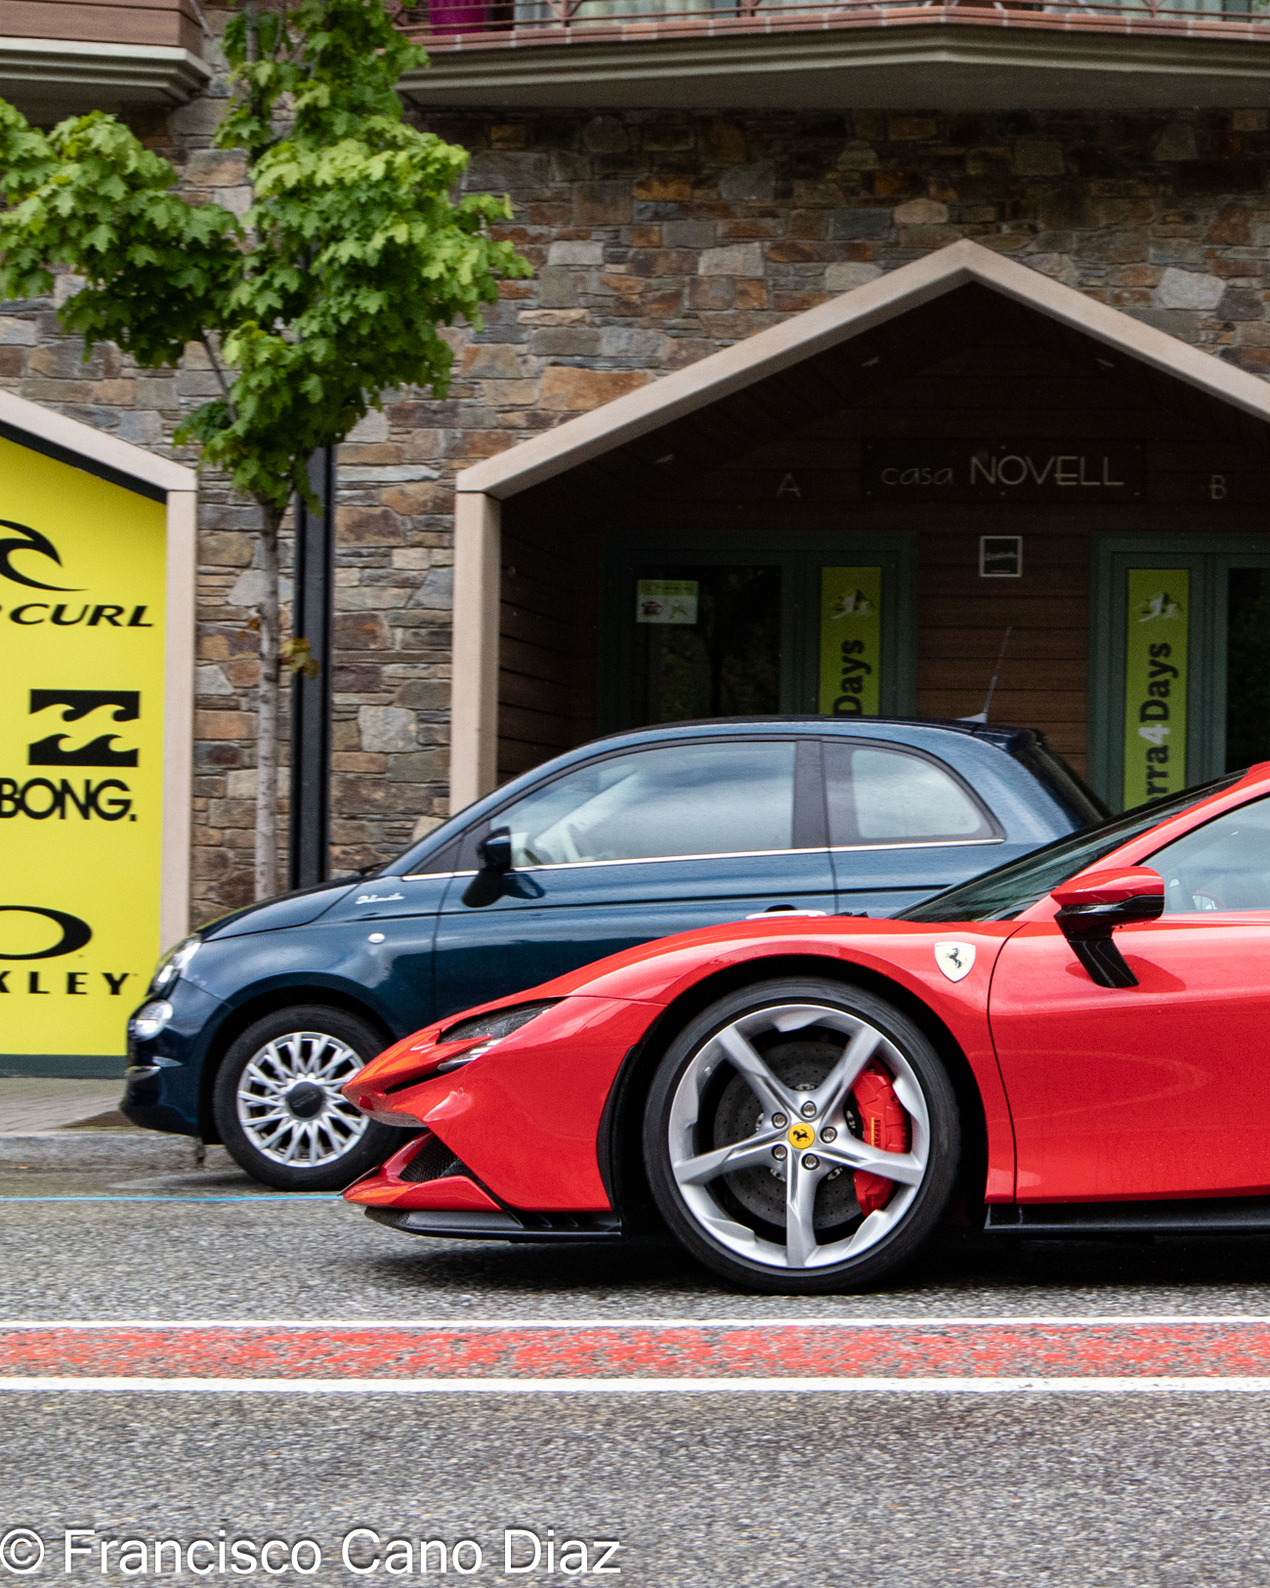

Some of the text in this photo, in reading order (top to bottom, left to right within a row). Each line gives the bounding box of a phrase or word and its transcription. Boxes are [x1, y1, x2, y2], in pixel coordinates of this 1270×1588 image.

[881, 455, 1125, 486] casa NOVELL
[776, 473, 802, 498] A
[1209, 474, 1228, 500] B
[9, 602, 155, 627] CURL
[1138, 641, 1179, 799] rra4Days
